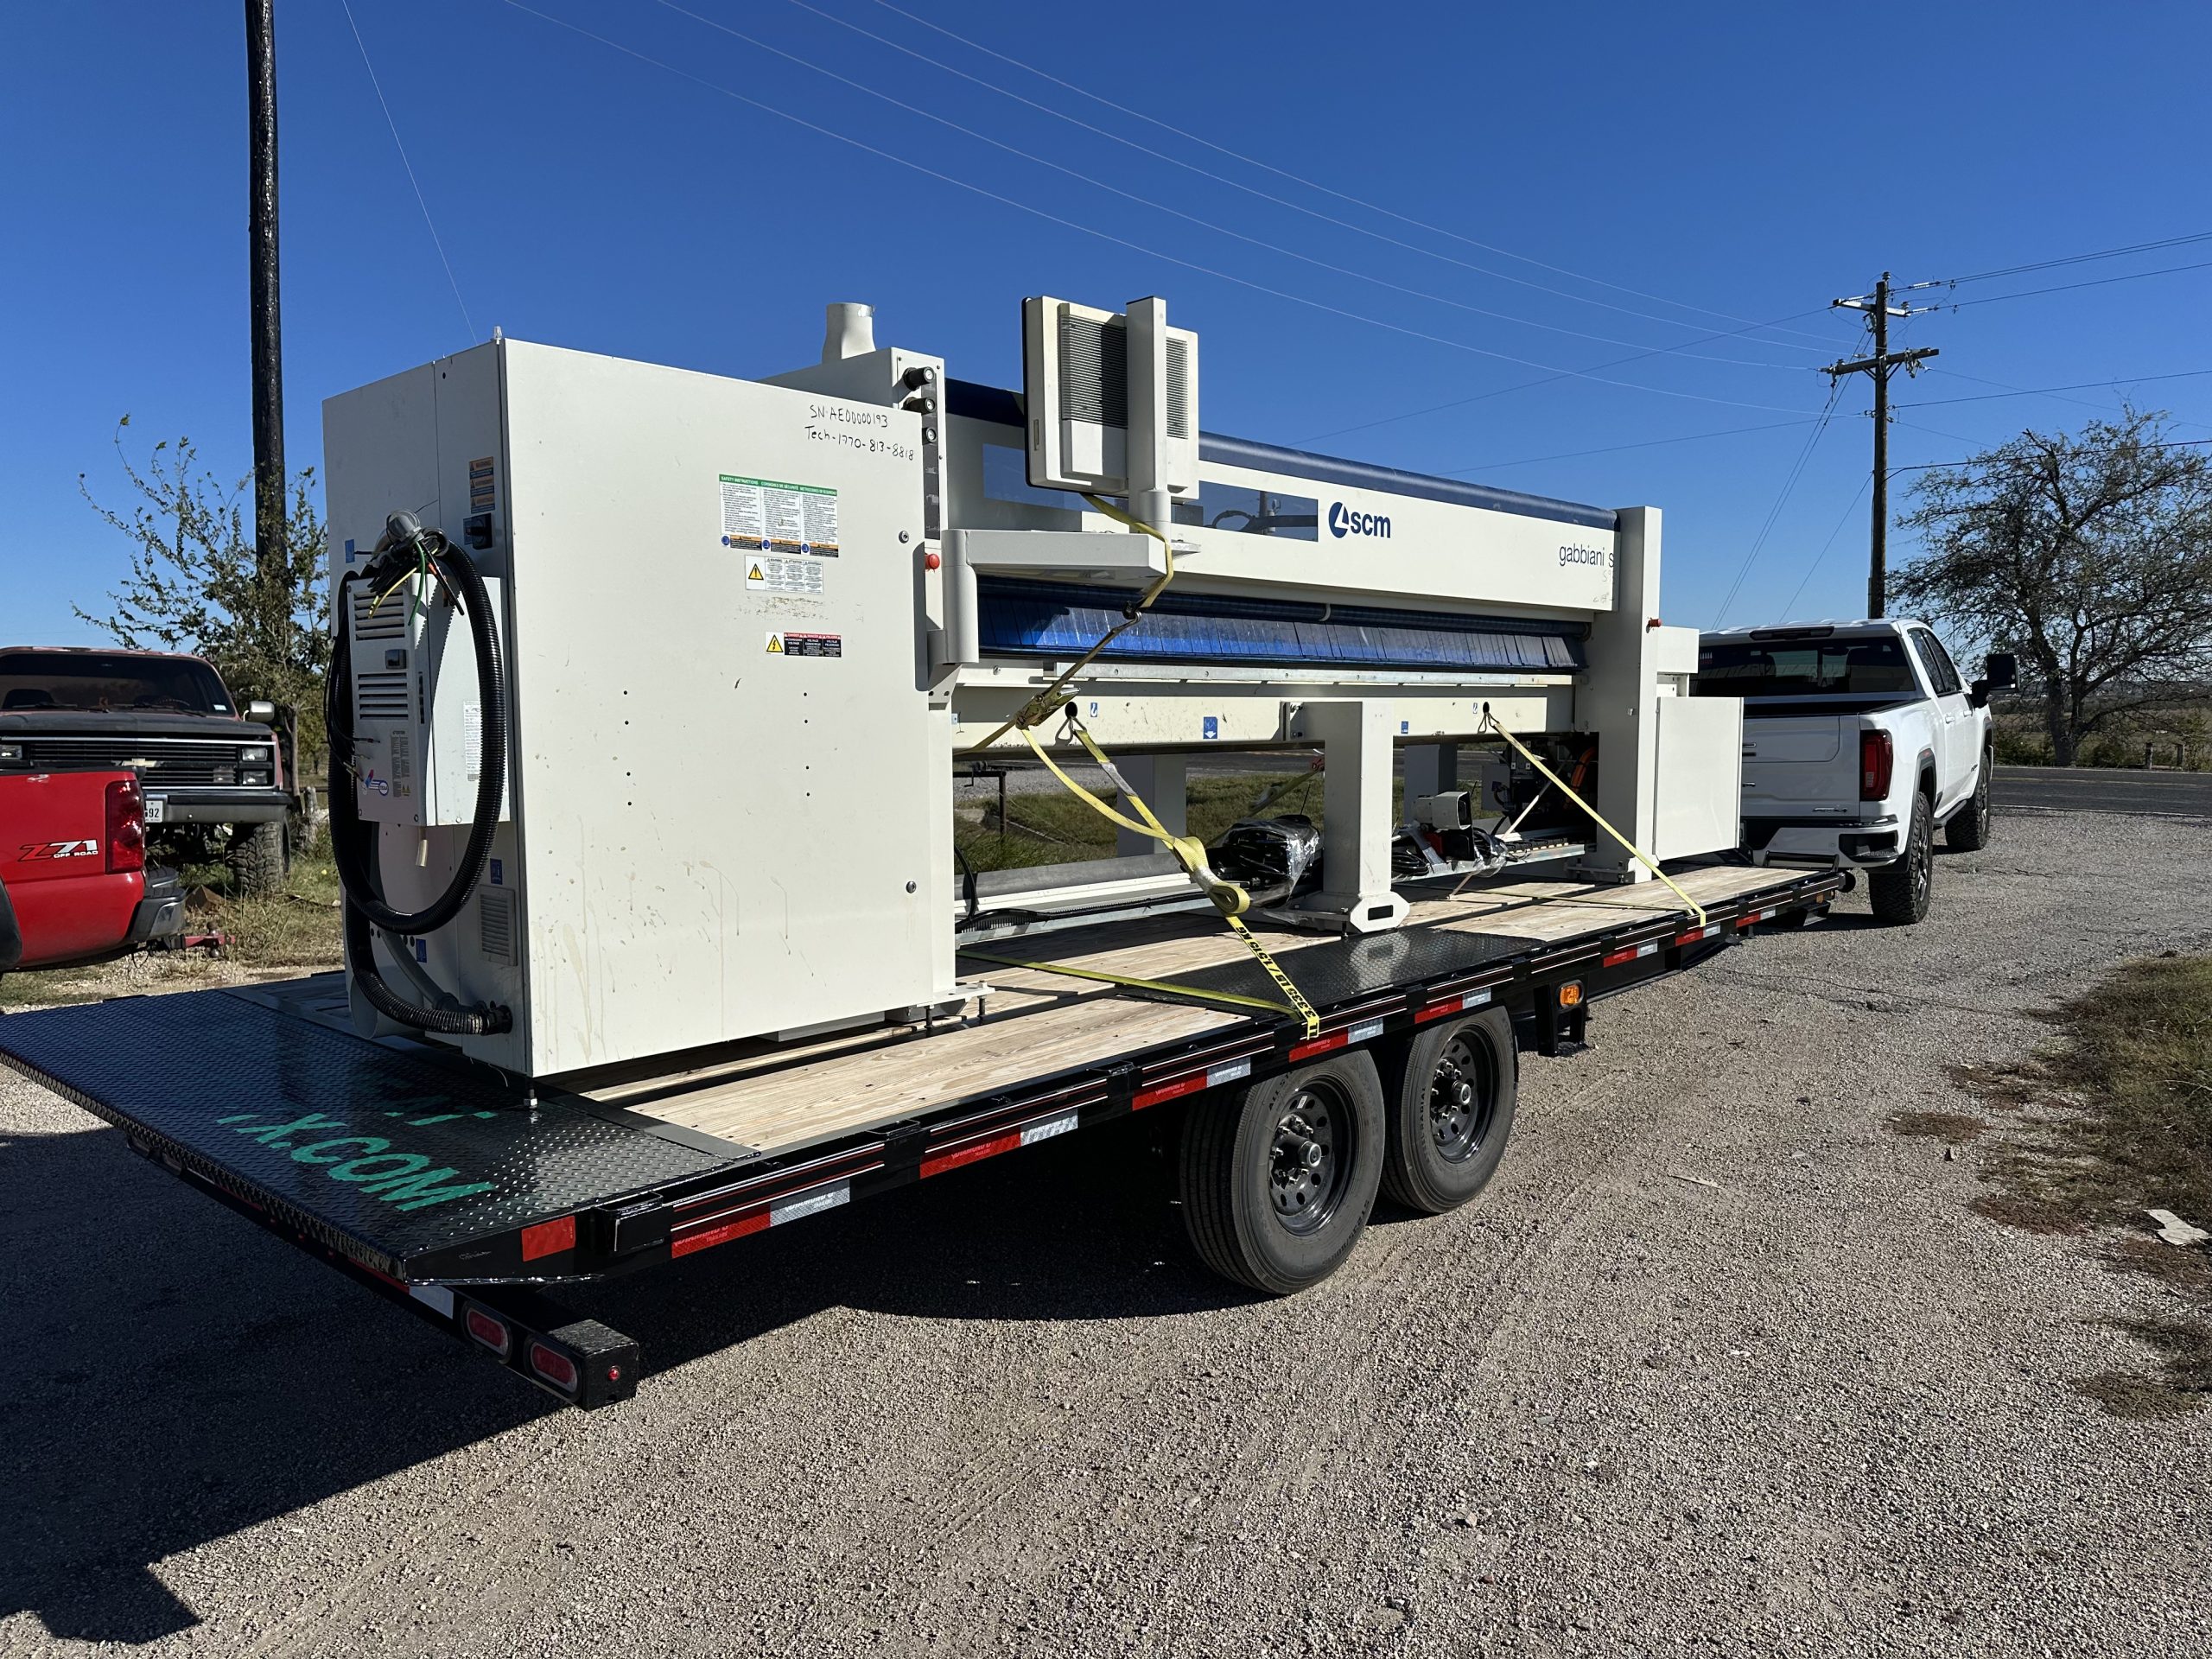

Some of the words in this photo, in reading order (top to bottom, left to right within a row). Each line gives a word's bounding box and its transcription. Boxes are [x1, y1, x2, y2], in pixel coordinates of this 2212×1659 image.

[1351, 512, 1390, 538] scm
[1559, 543, 1605, 567] gabbiani
[17, 839, 98, 862] Z71
[1236, 926, 1253, 940] KG
[1249, 941, 1274, 964] 1,515
[1275, 974, 1292, 987] LB
[1286, 988, 1315, 1018] 3,335
